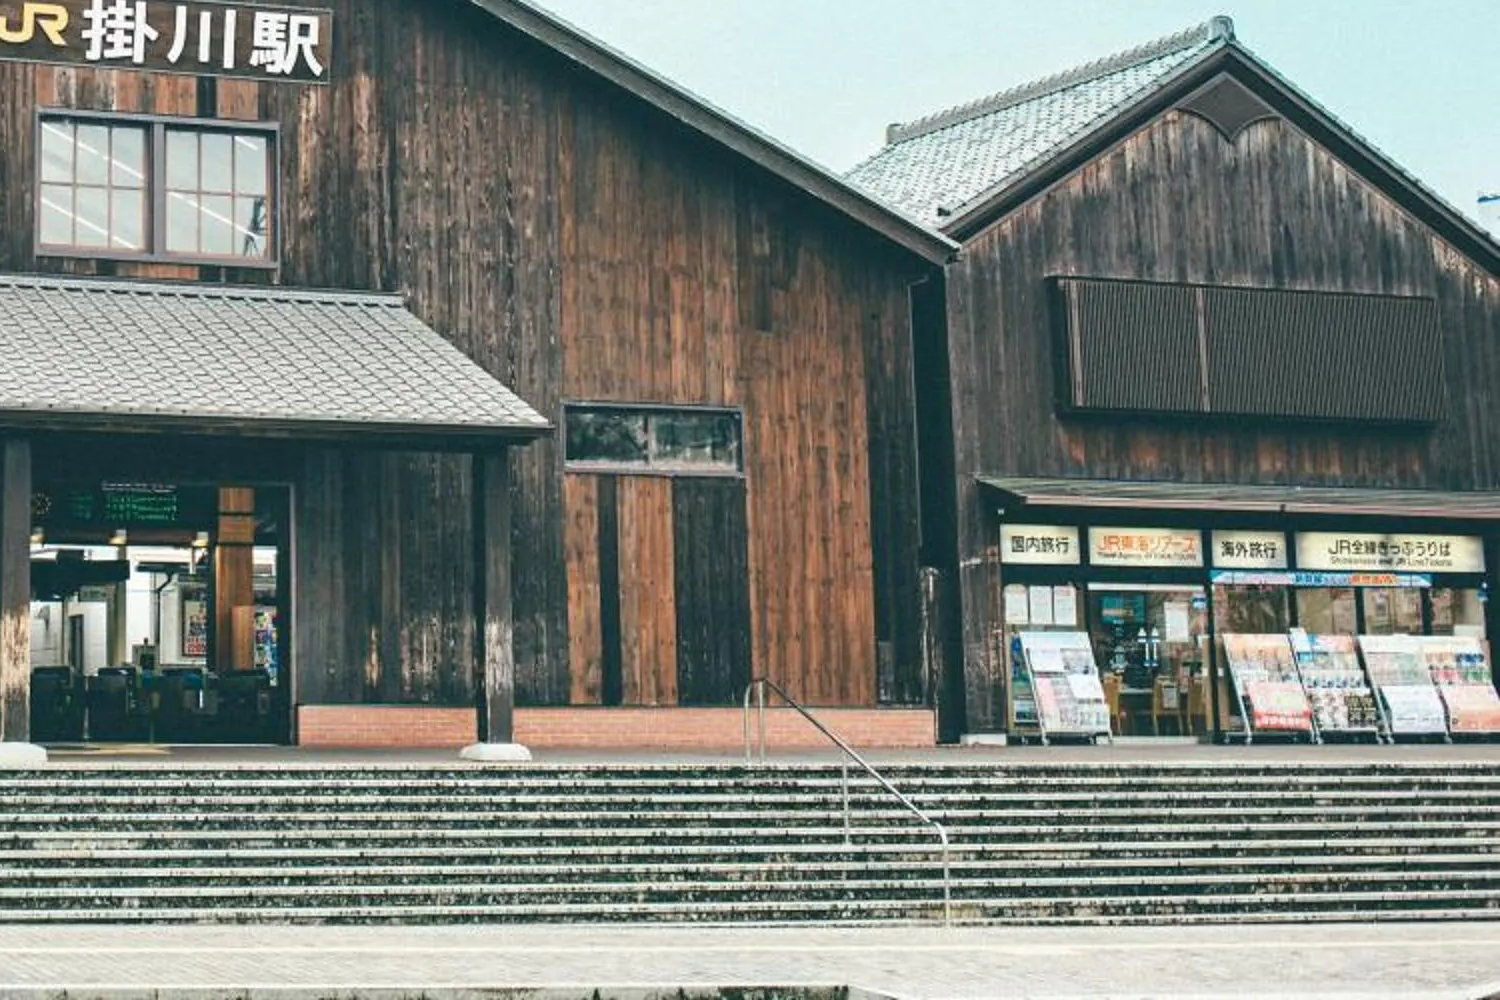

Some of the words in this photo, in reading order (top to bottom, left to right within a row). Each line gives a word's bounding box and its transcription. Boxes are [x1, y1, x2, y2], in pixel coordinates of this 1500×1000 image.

[1011, 535, 1069, 554] 国内旅行
[1221, 541, 1277, 559] 海外旅行
[1328, 539, 1451, 557] JR全線きっぷうりば
